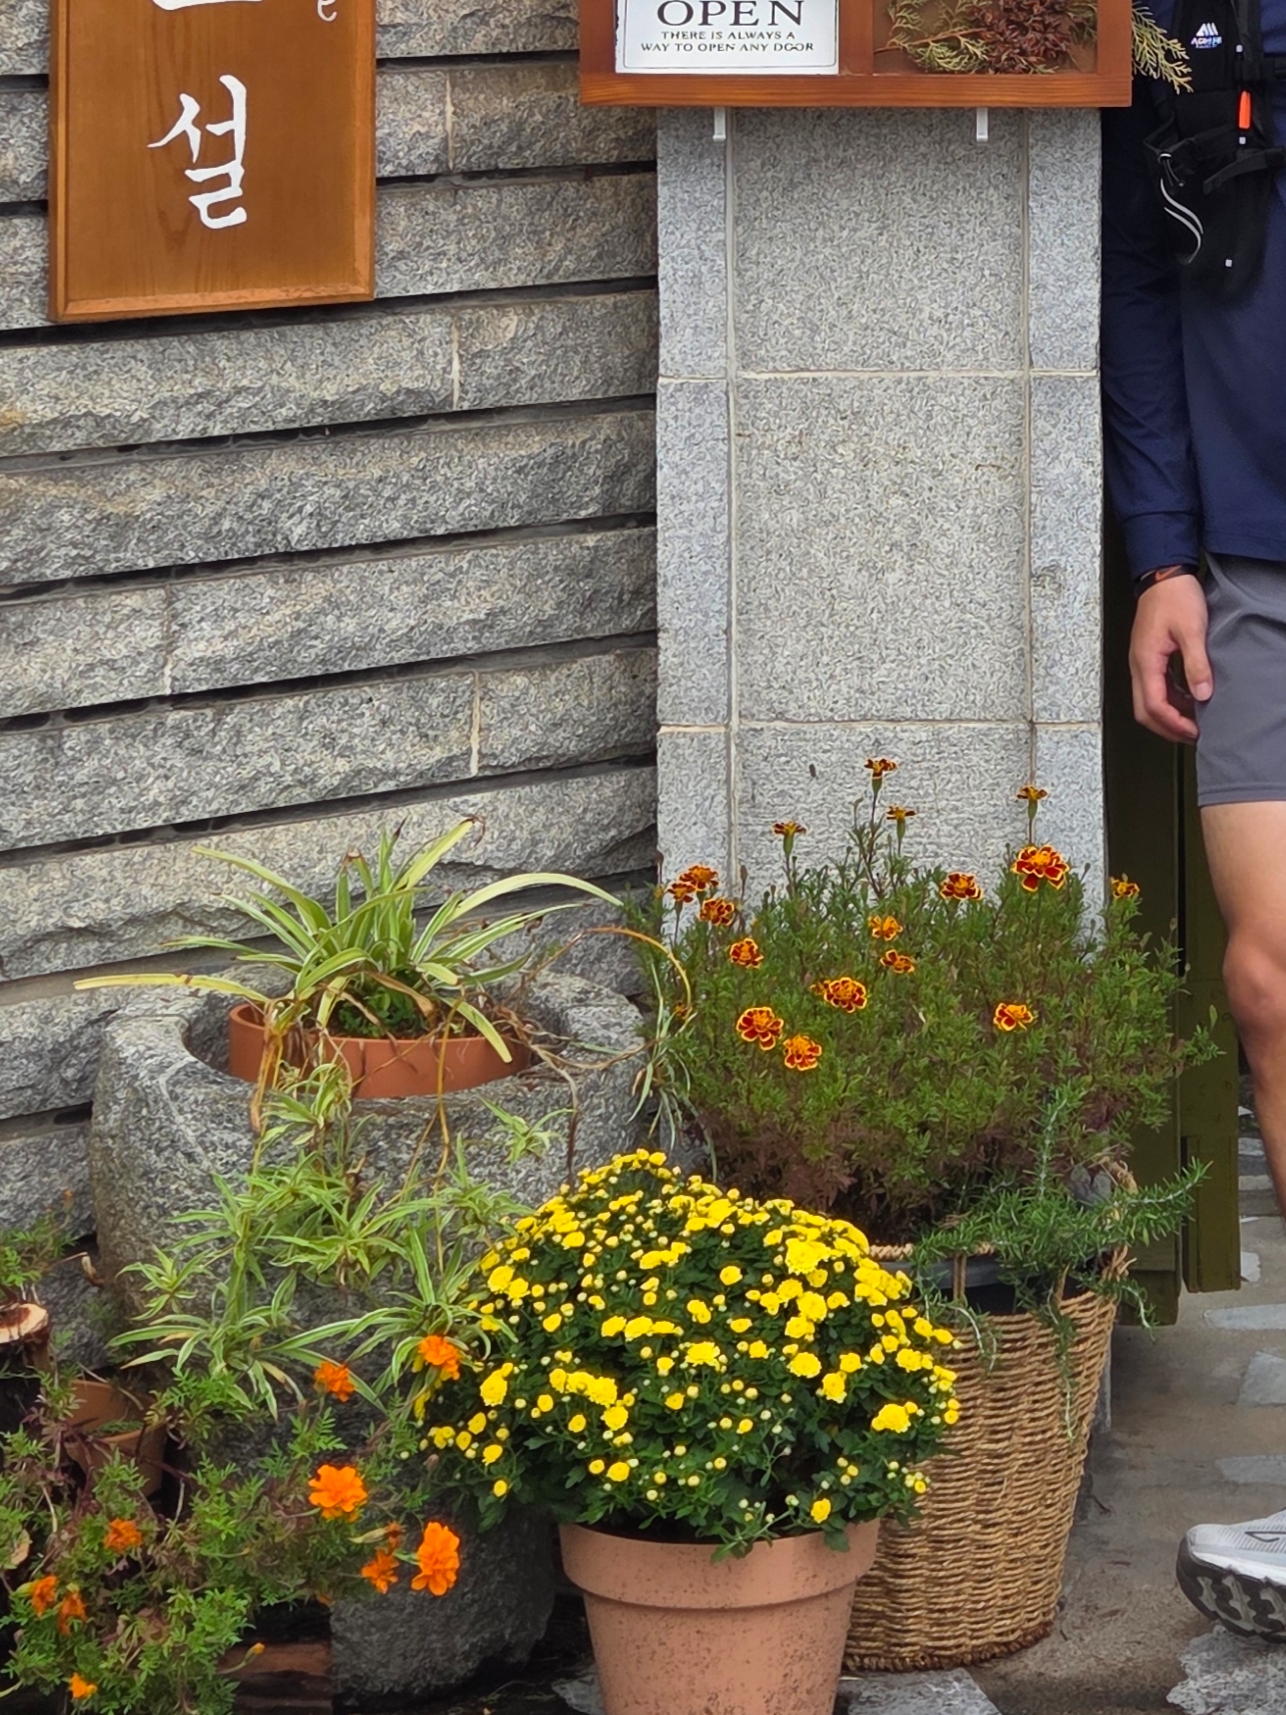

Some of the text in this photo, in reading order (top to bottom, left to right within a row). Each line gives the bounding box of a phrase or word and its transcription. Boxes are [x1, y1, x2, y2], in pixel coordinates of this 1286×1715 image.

[657, 0, 805, 27] OPEN
[661, 31, 796, 40] THERE IS ALWAYS A
[641, 43, 814, 52] WAY TO OPEN ANY DOOR
